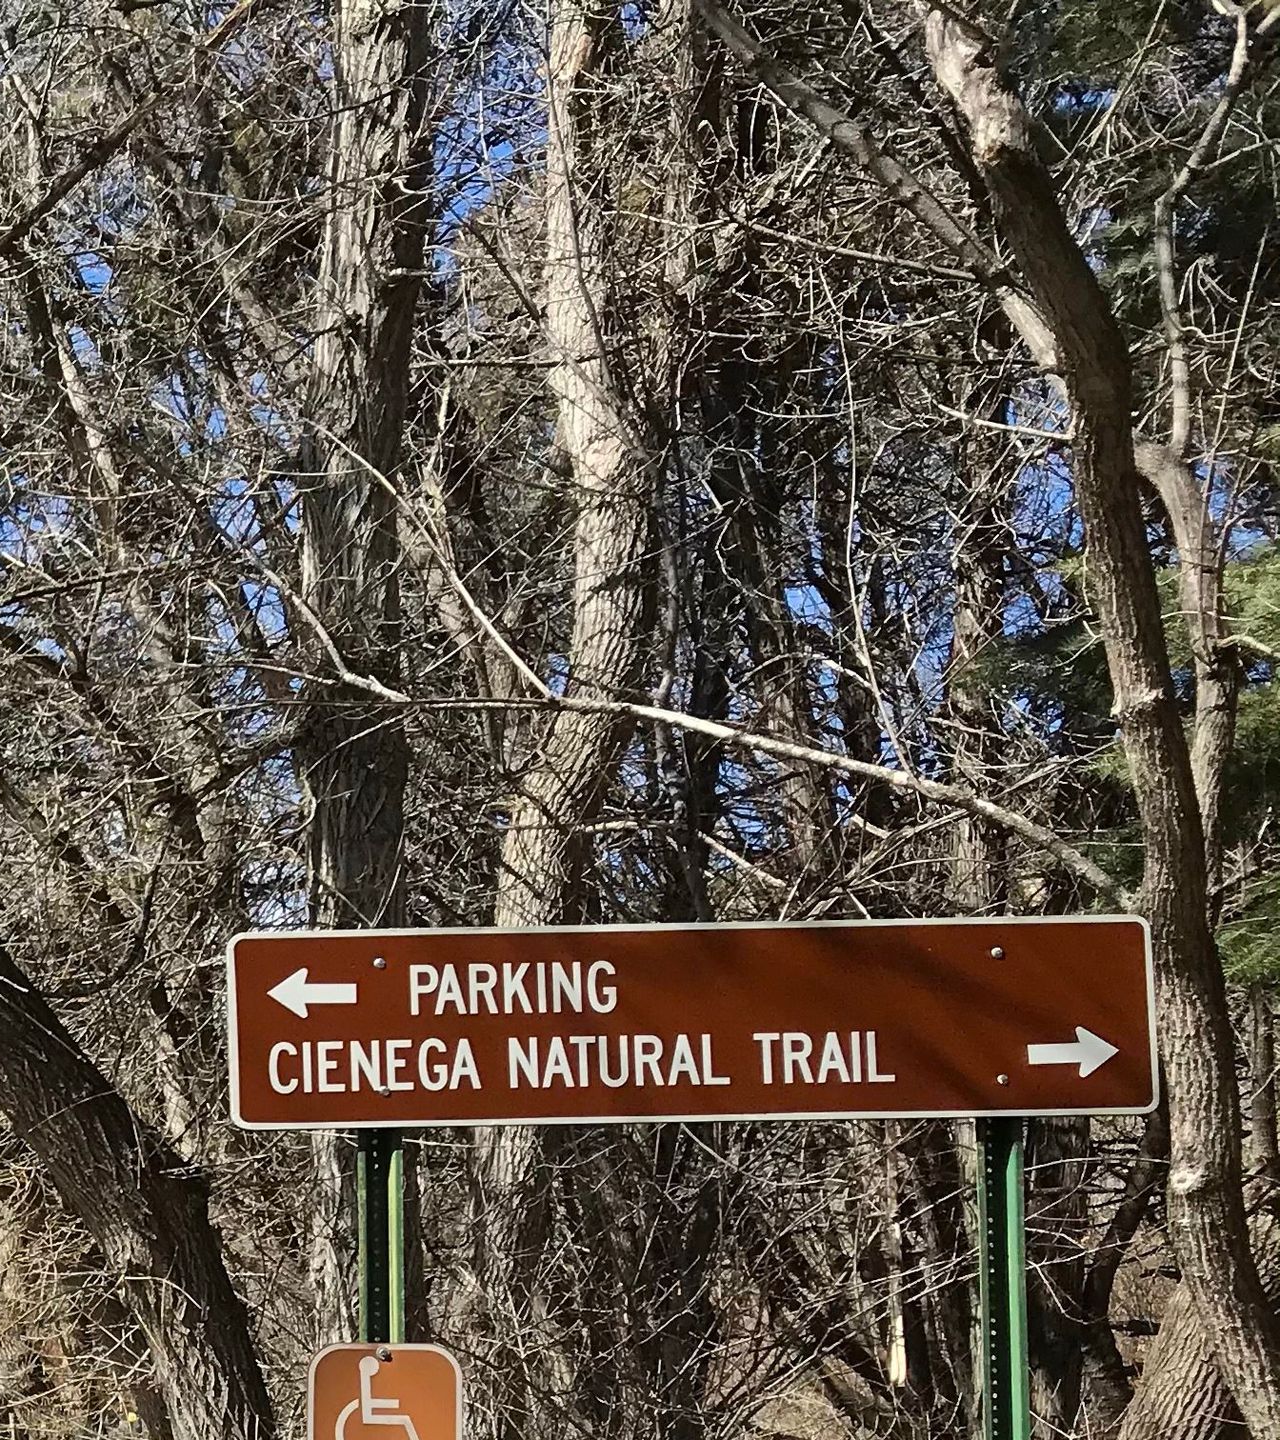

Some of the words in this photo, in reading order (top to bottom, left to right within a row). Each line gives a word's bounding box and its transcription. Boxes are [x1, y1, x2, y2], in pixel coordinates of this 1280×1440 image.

[410, 960, 618, 1016] PARKING
[269, 1037, 481, 1095] CIENEGA
[509, 1033, 730, 1088] NATURAL
[753, 1031, 896, 1084] TRAIL
